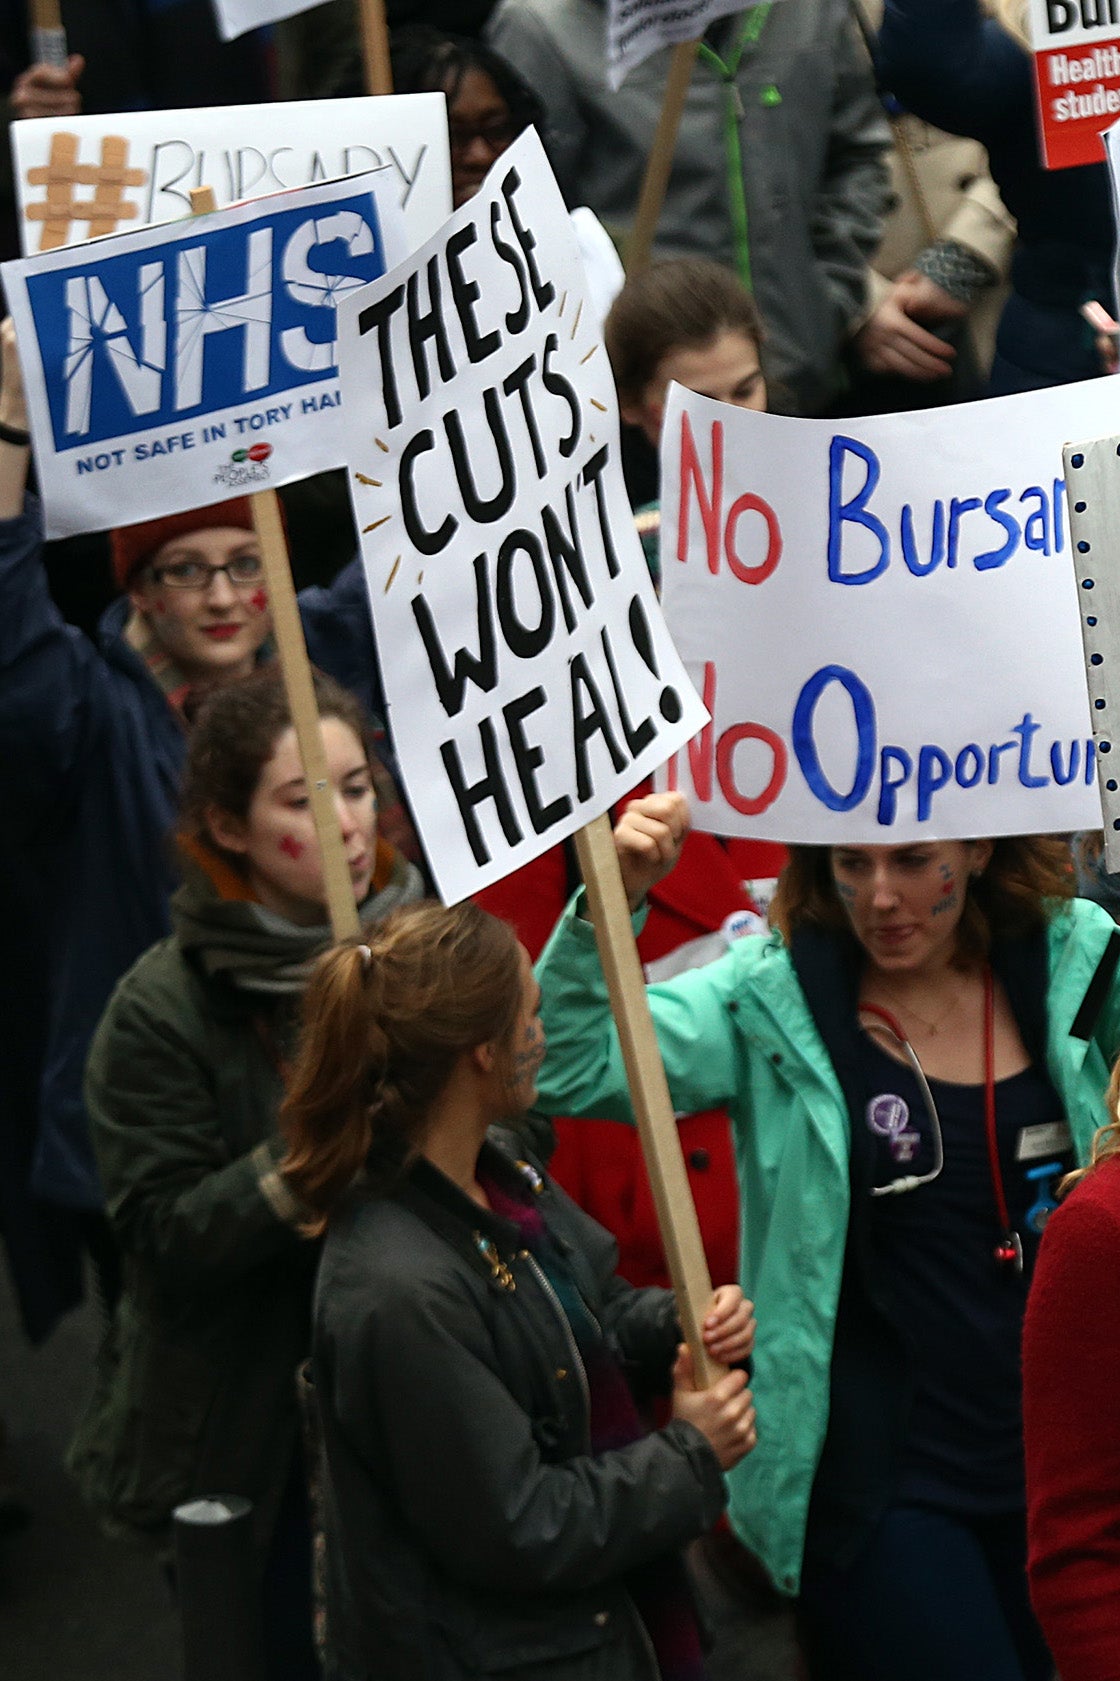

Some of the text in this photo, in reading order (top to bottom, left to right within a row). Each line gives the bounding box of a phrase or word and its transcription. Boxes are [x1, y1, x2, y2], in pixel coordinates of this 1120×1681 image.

[63, 210, 376, 437] NHS
[359, 167, 556, 429] THESE
[77, 404, 293, 475] NOT SAFE IN TORY
[399, 334, 582, 556] CUTS
[677, 410, 783, 585] No
[412, 444, 621, 718] WON'T
[440, 594, 684, 867] HEAL!
[668, 661, 787, 816] No
